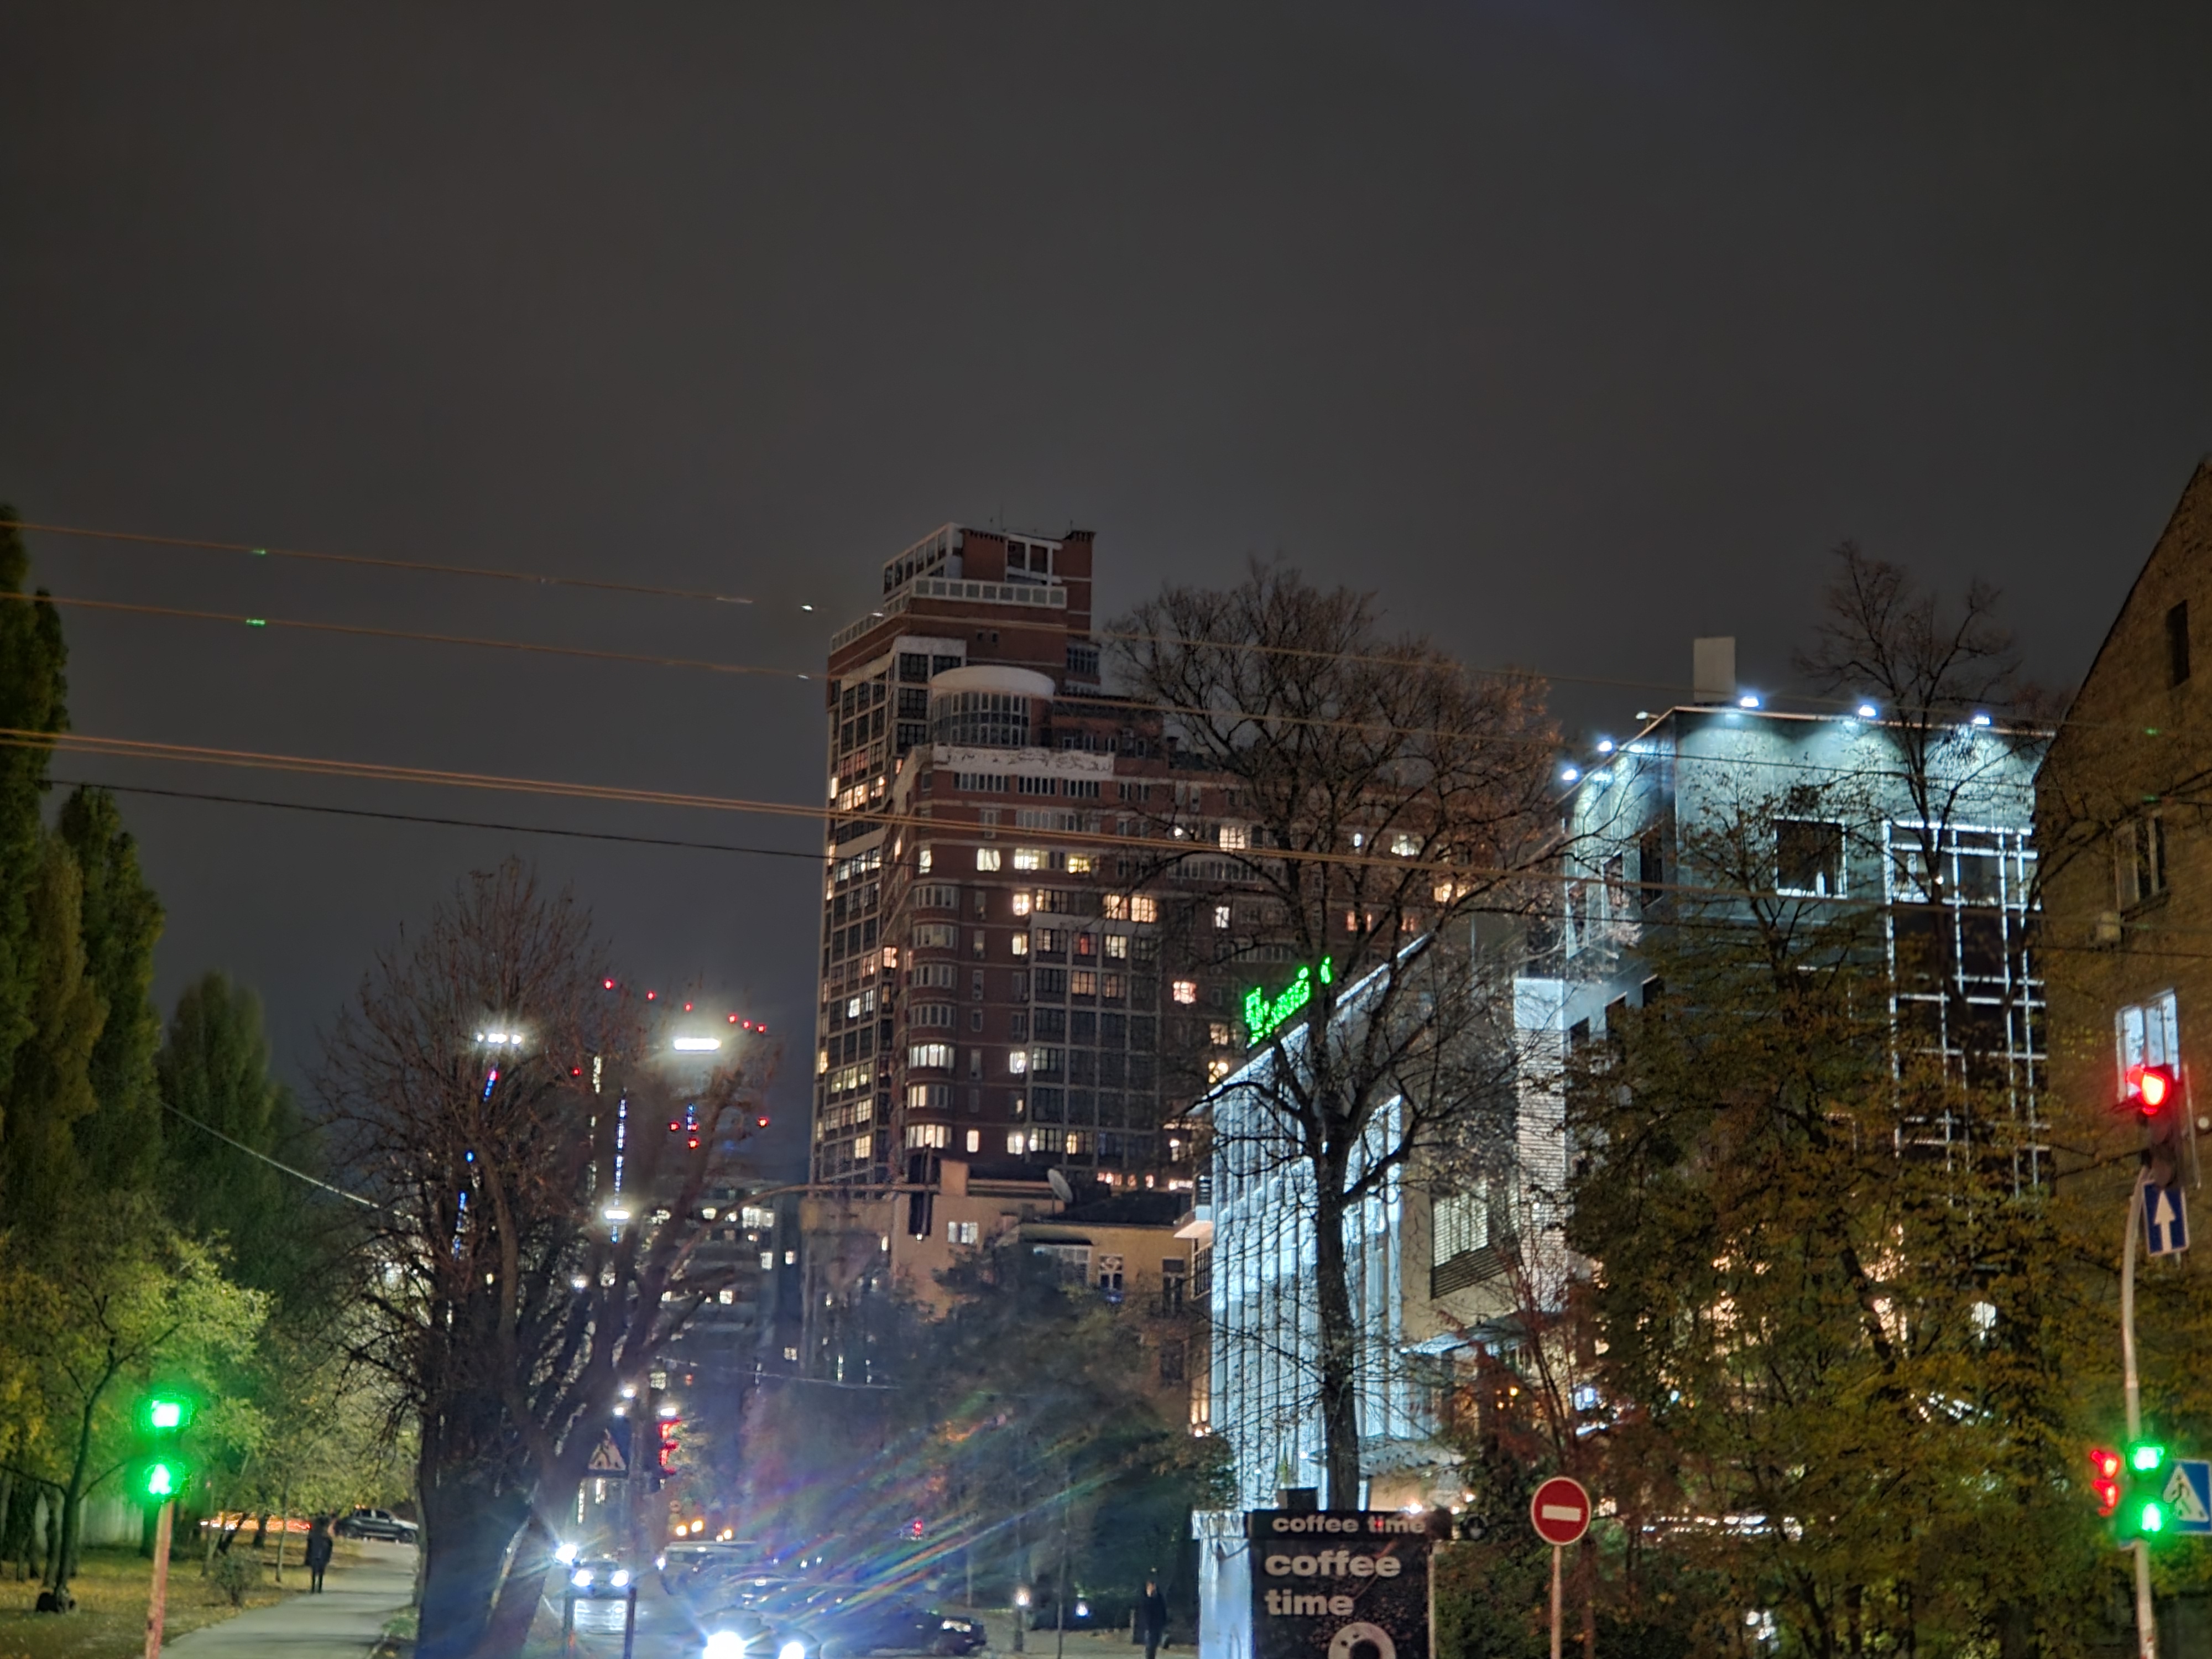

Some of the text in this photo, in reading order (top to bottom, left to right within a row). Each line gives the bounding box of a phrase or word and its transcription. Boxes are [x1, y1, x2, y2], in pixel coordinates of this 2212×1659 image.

[1272, 1515, 1426, 1534] coffee time
[1265, 1550, 1401, 1577] coffee
[1265, 1589, 1354, 1616] time
